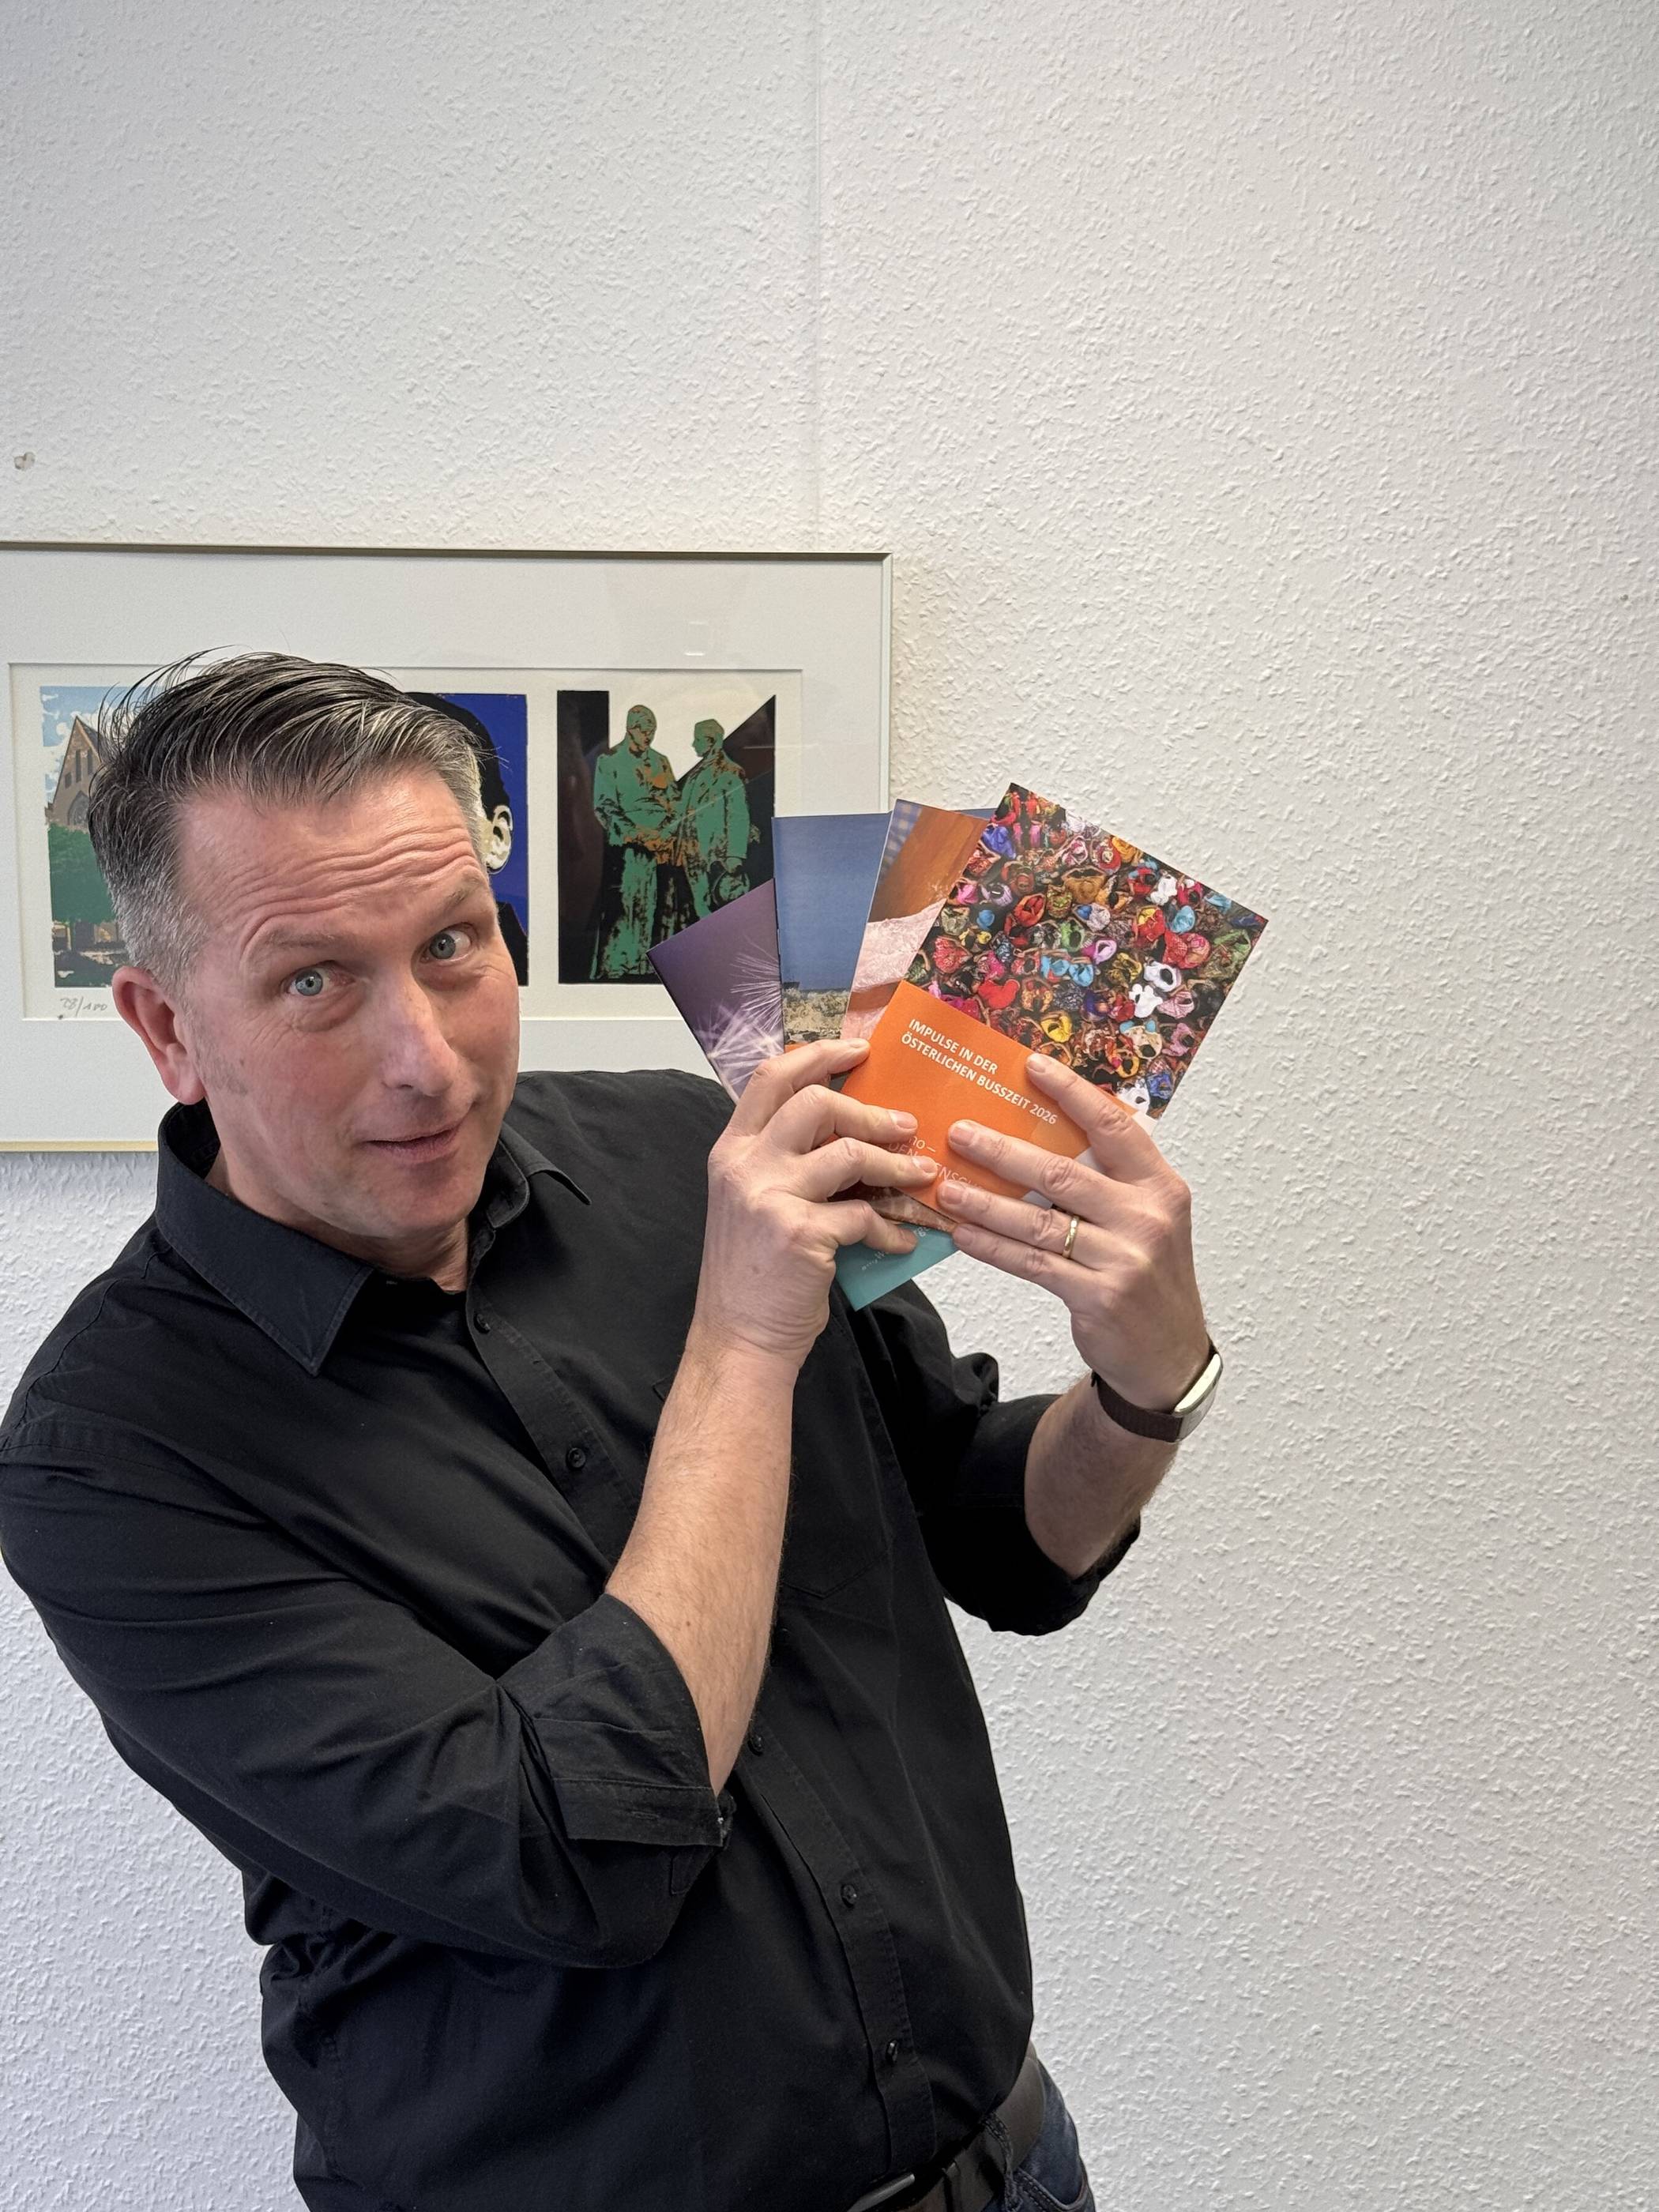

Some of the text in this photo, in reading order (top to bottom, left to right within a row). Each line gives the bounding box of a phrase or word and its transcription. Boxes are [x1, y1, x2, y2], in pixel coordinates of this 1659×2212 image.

[901, 1030, 1059, 1125] ÖSTERLICHEN BUSSZEIT 2026
[908, 1018, 999, 1075] IMPULSE IN DER
